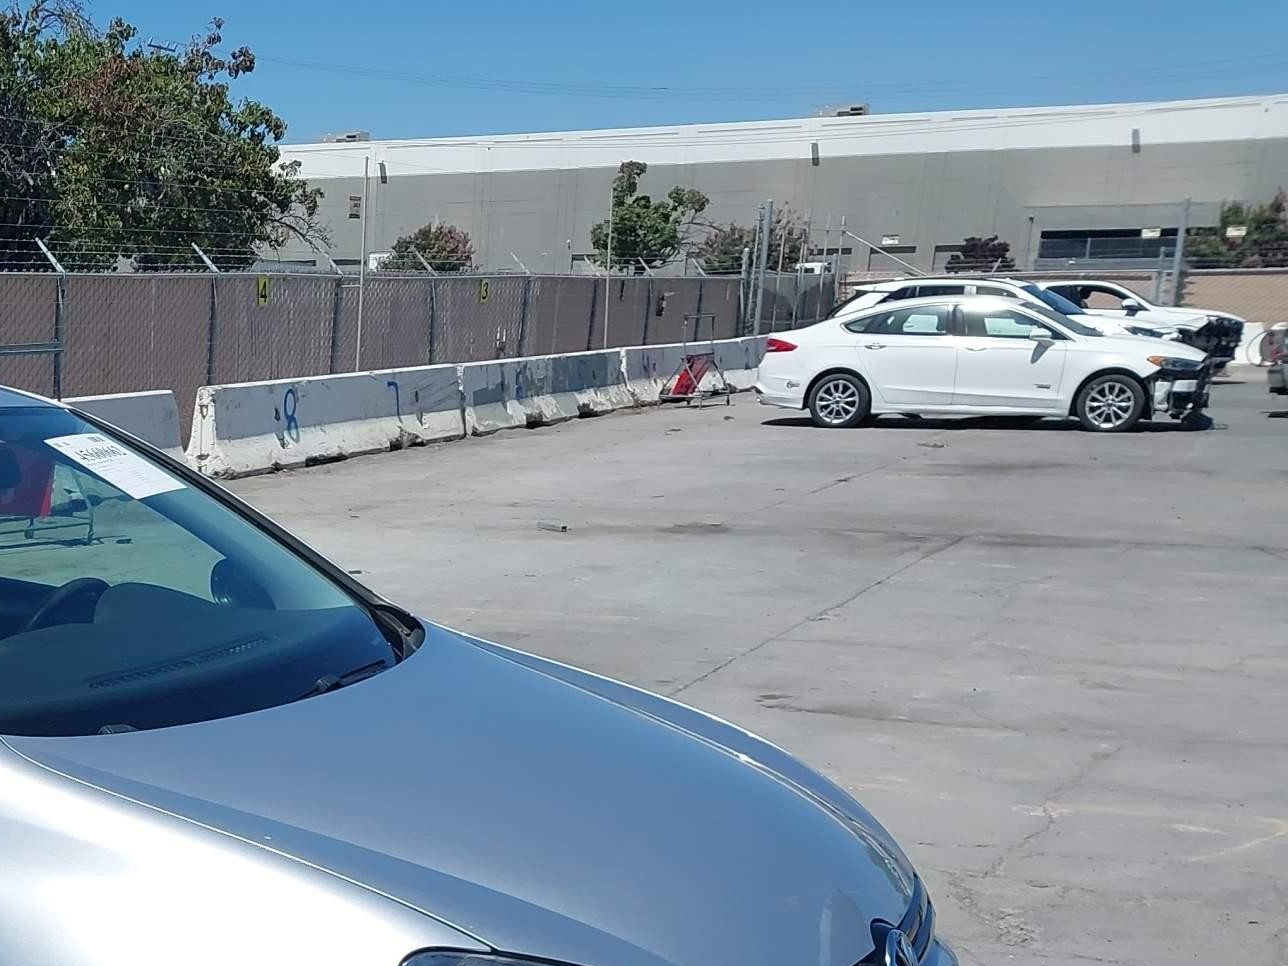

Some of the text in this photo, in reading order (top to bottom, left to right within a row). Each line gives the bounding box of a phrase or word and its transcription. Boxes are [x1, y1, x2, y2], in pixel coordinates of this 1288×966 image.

[260, 280, 268, 303] 4
[481, 281, 489, 300] 3
[283, 388, 300, 443] 8
